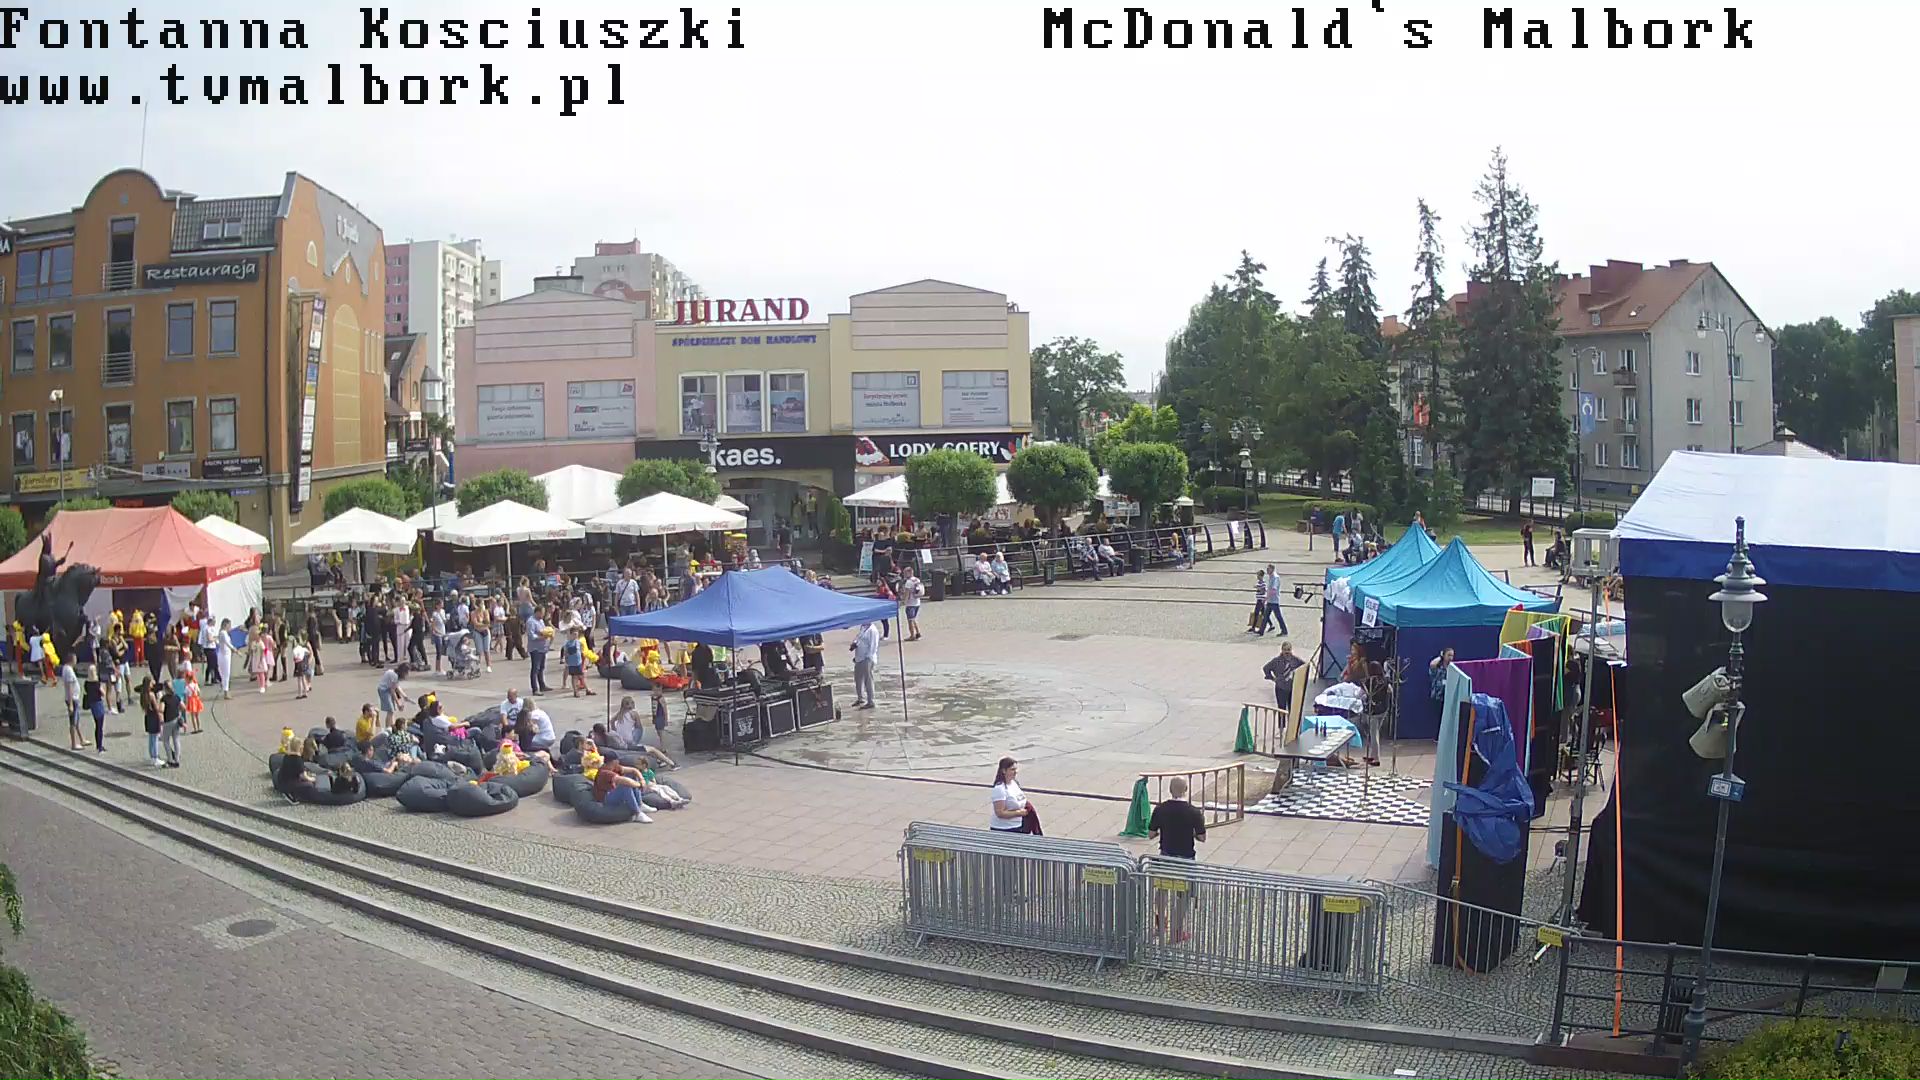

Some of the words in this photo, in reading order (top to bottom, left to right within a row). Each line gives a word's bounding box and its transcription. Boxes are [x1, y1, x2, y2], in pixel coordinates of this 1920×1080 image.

[145, 259, 257, 281] Restauracja
[676, 297, 809, 326] JURAND
[741, 336, 761, 345] DOM
[766, 334, 816, 345] HANDLOWY
[890, 443, 936, 458] LODY
